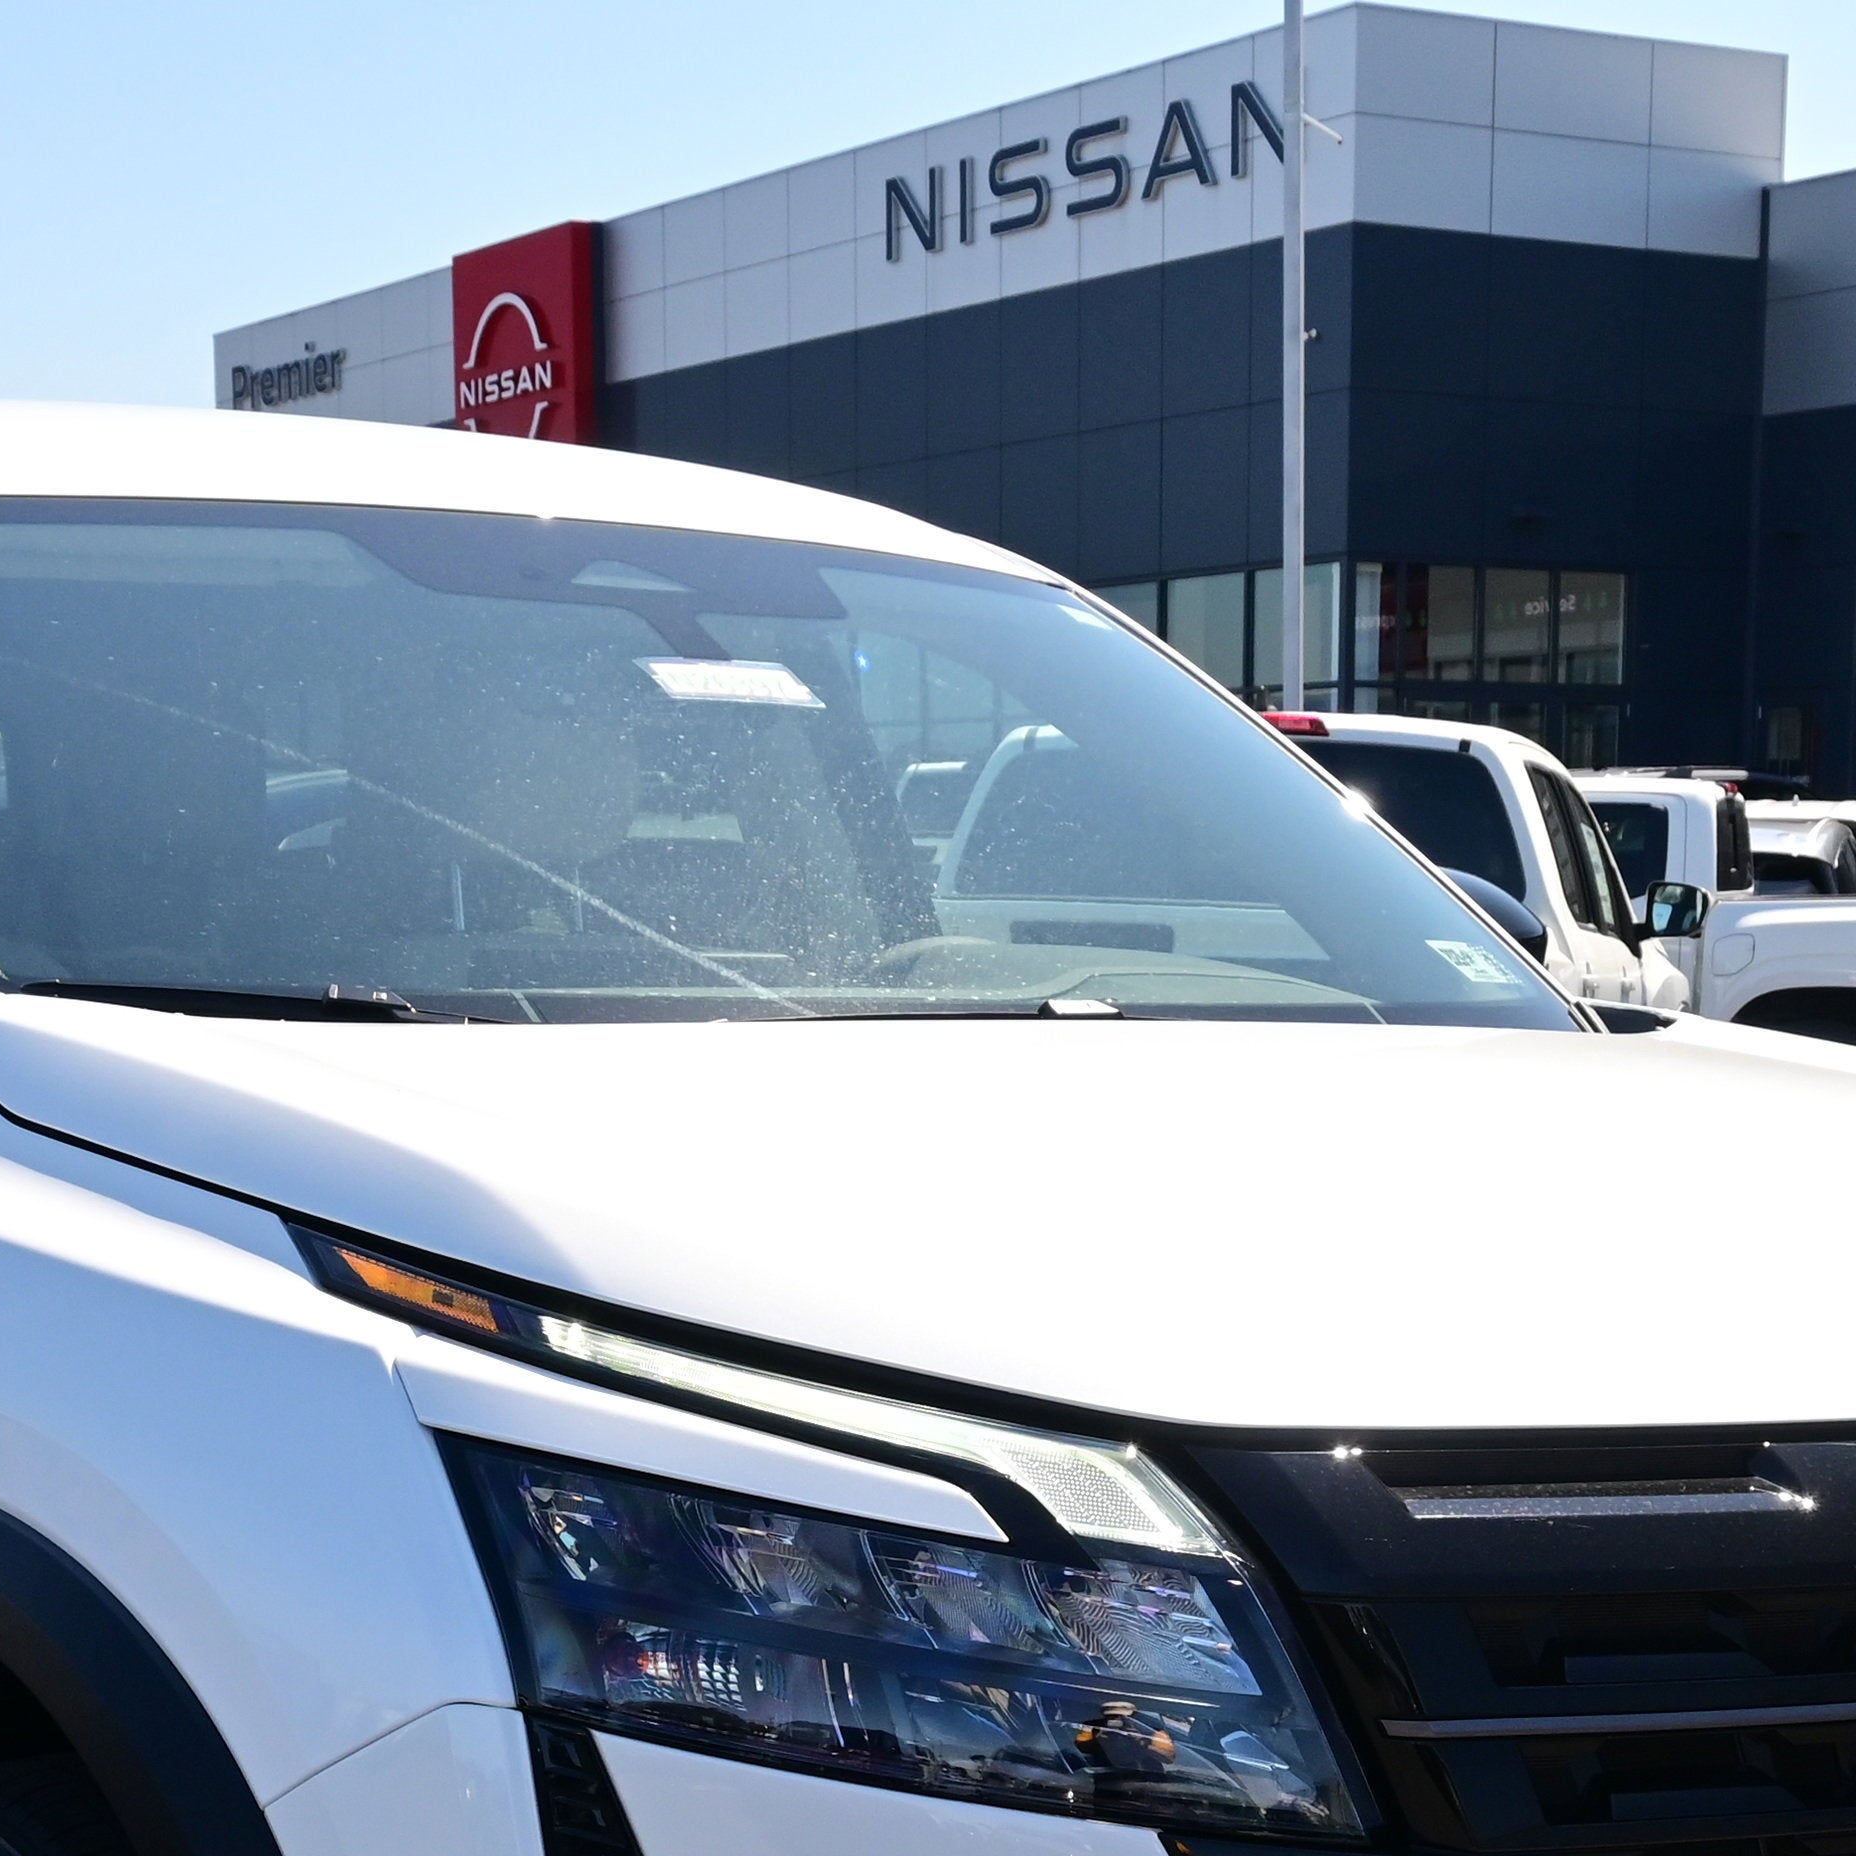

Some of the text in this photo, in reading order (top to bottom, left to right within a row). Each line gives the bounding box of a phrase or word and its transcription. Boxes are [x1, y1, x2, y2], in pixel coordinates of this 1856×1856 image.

[886, 80, 1284, 262] NISSAN
[231, 341, 346, 411] Premier
[460, 360, 552, 409] NISSAN
